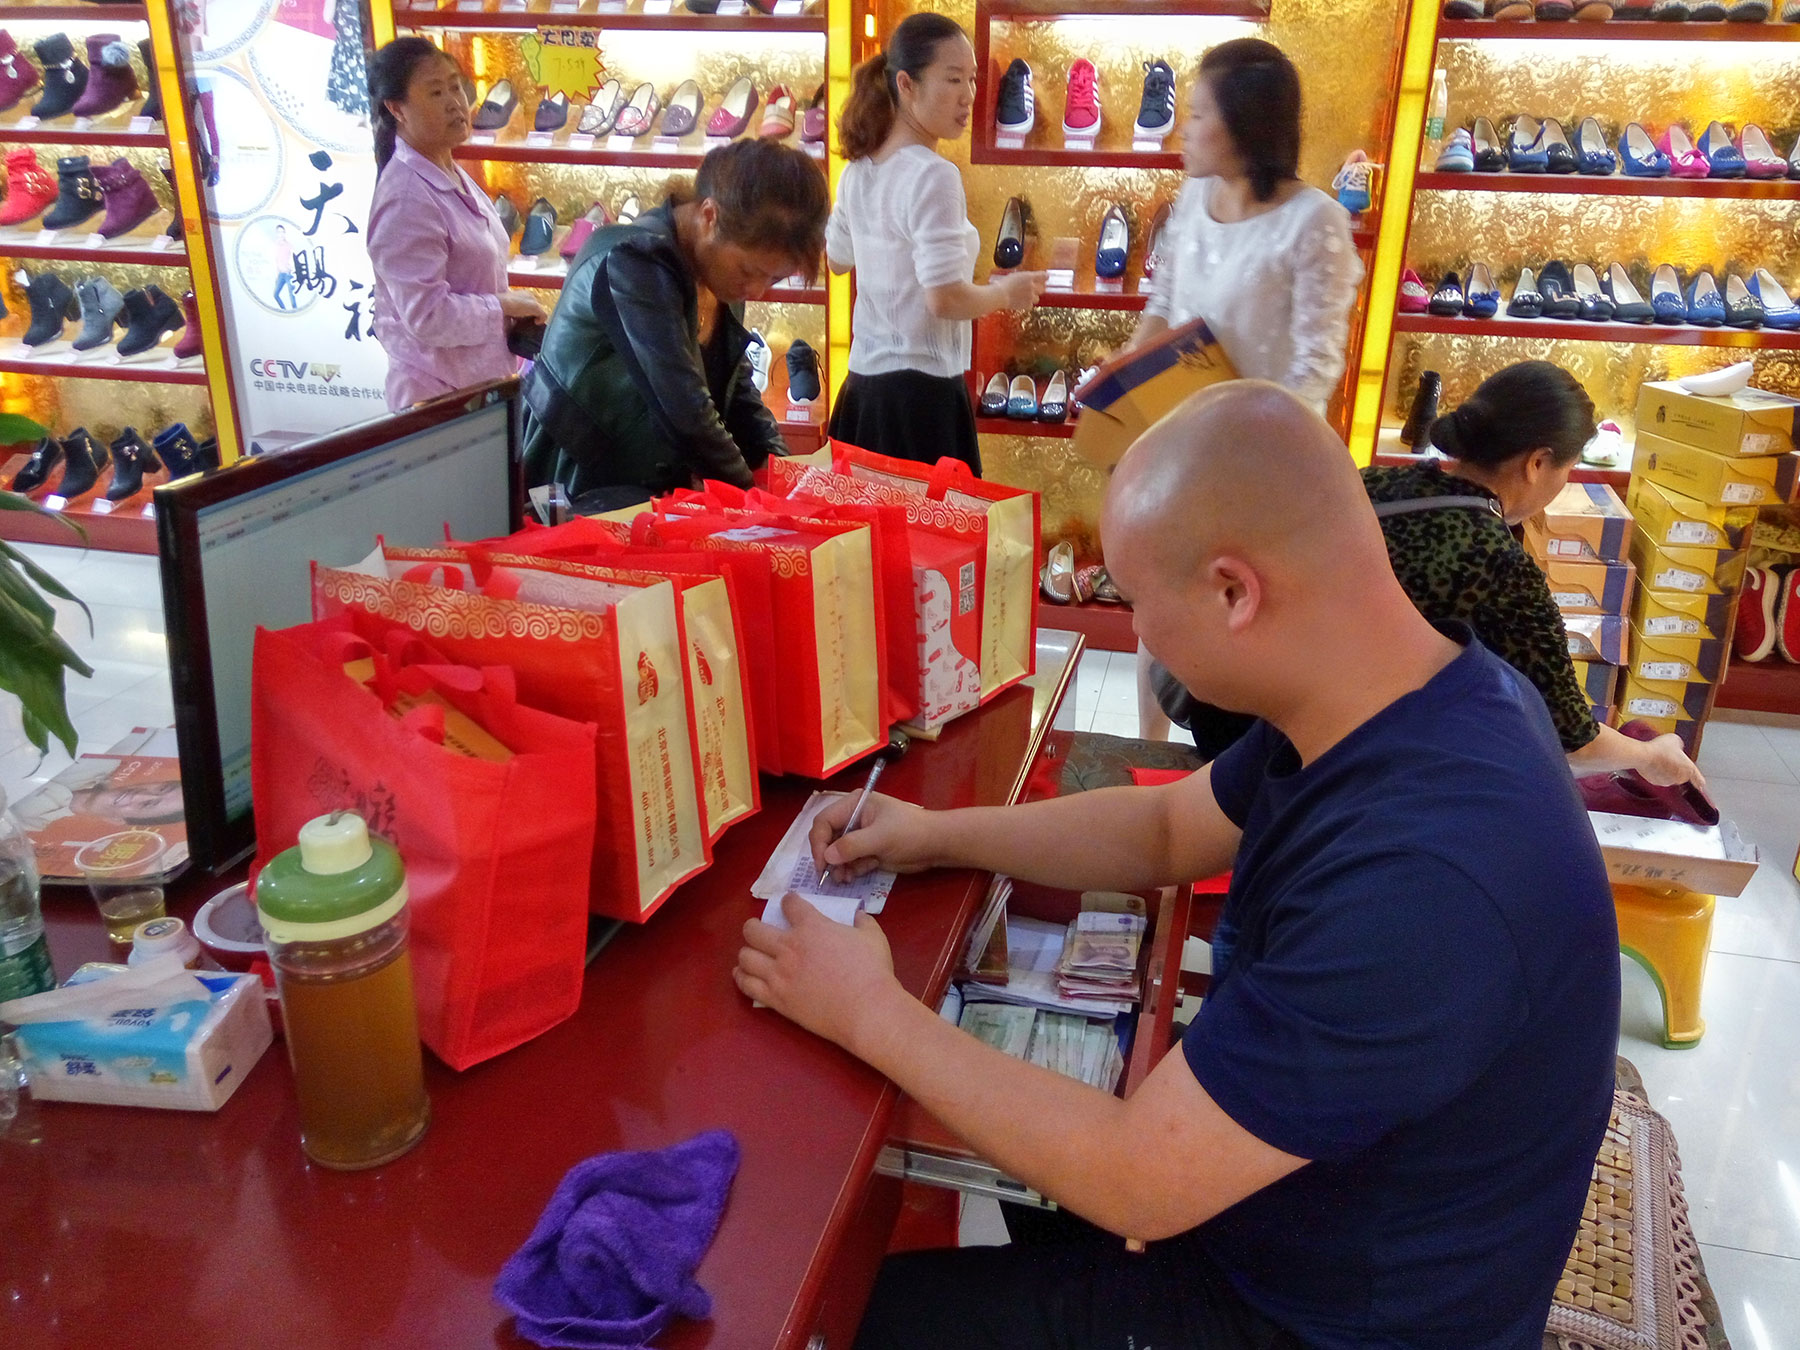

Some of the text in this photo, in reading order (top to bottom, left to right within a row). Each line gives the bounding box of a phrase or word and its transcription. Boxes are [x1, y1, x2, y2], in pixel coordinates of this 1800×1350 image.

[250, 358, 308, 380] CCTV
[253, 380, 387, 400] 中国中央电视台战略合作伙
